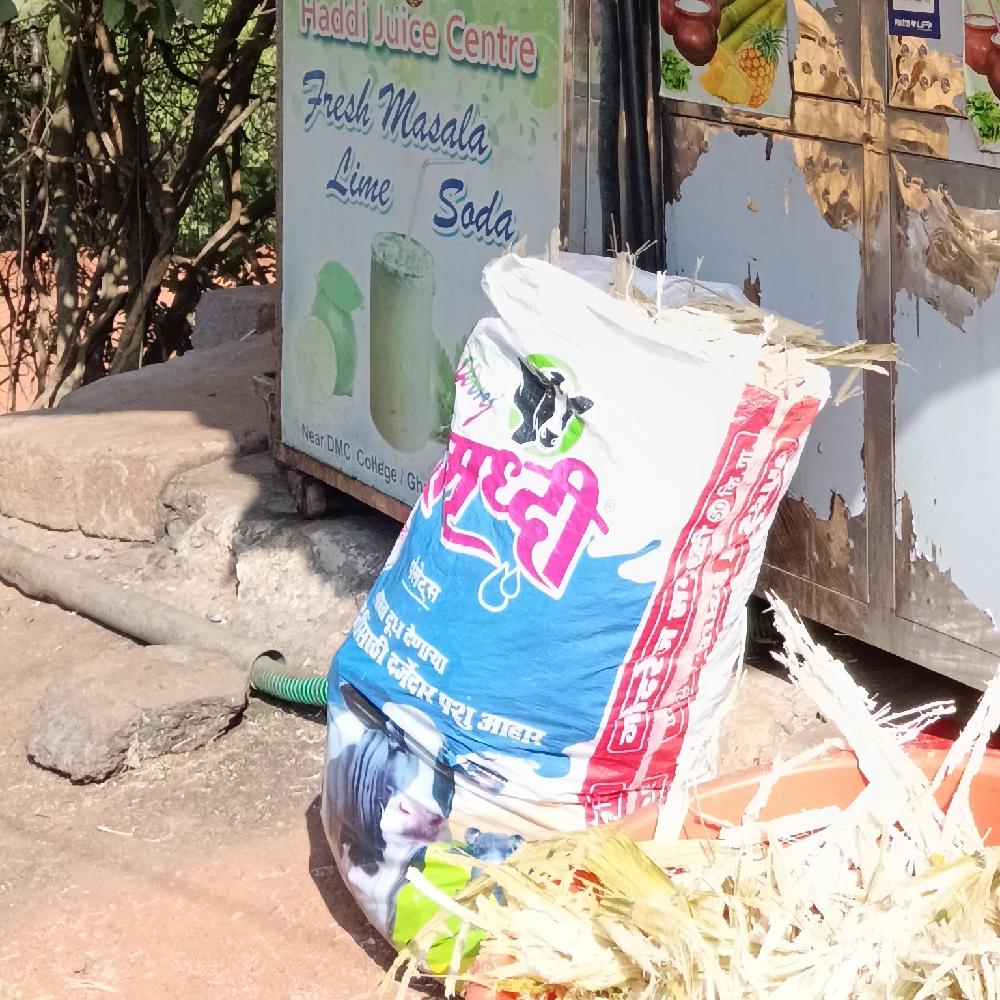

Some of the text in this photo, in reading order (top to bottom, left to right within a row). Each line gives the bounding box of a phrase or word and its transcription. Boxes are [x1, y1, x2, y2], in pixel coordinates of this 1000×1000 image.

[374, 3, 438, 51] Juice
[446, 14, 536, 69] Centre
[302, 69, 489, 157] Fresh Masala
[326, 146, 391, 207] Lime
[432, 177, 516, 242] Soda
[301, 422, 326, 447] Near
[326, 433, 351, 461] DMC
[356, 447, 398, 485] College
[476, 712, 548, 747] आहार
